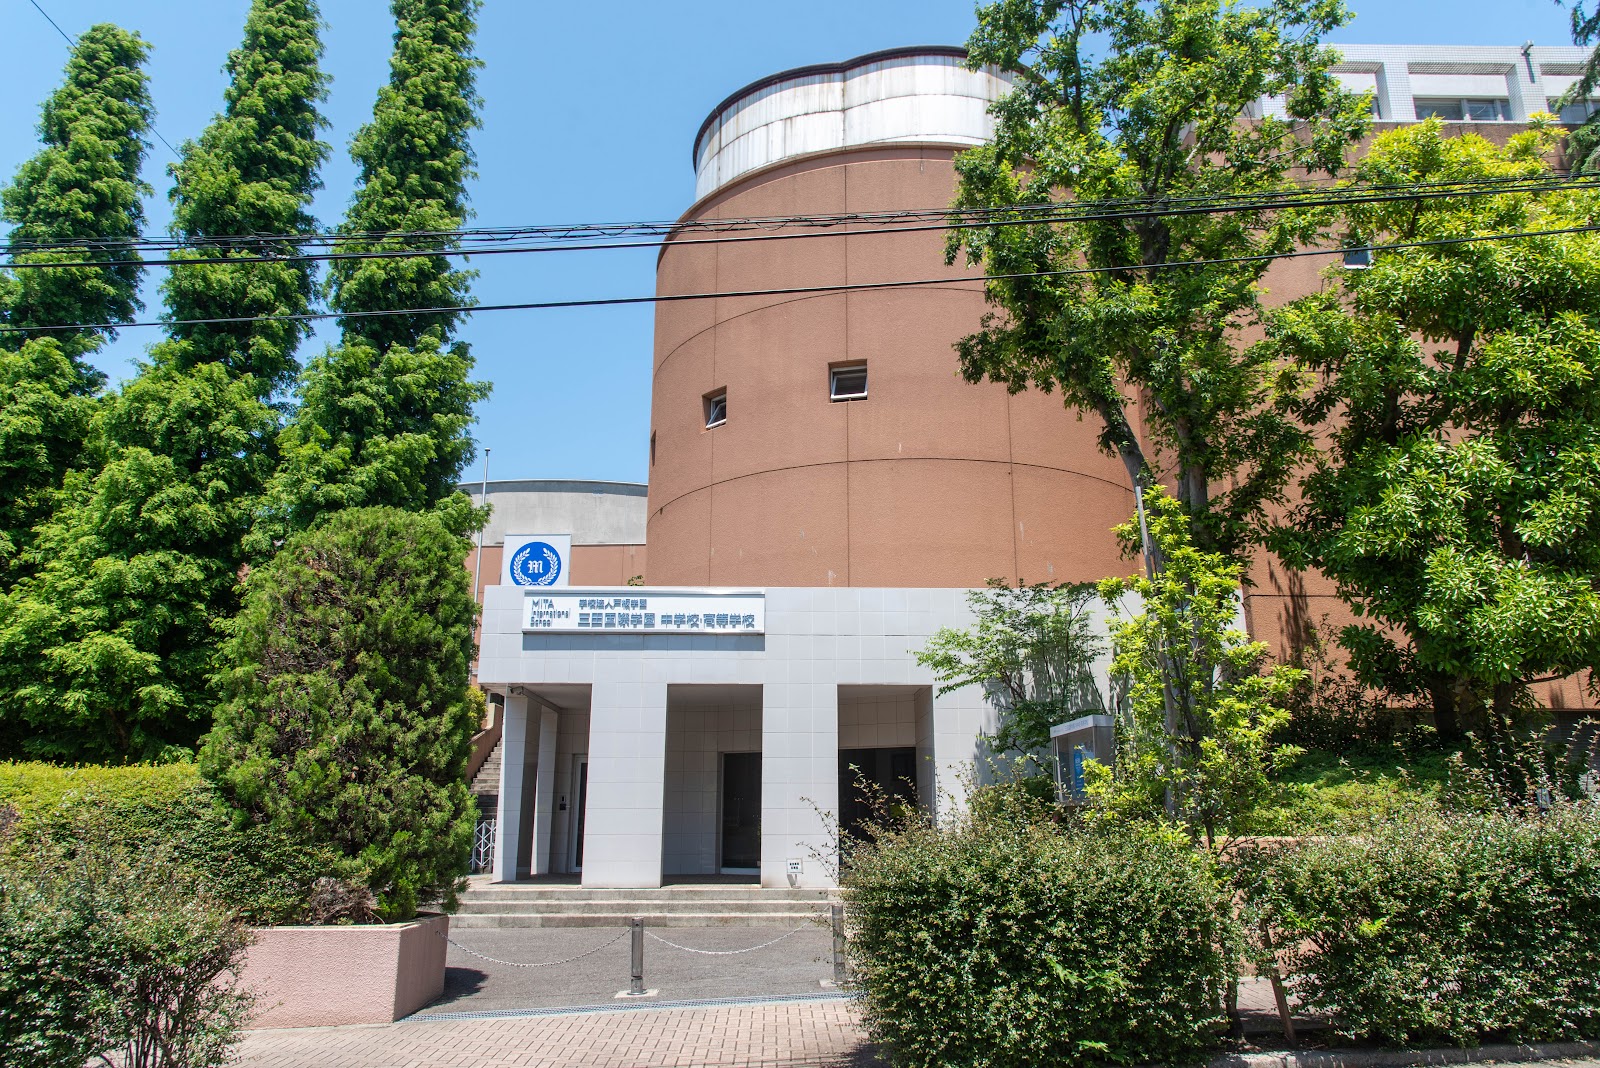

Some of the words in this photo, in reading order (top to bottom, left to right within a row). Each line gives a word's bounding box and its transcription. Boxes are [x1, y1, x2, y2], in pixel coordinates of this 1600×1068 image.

[532, 598, 554, 610] MITA
[531, 608, 571, 619] International
[530, 616, 553, 627] School
[578, 612, 655, 628] 三田国際学園
